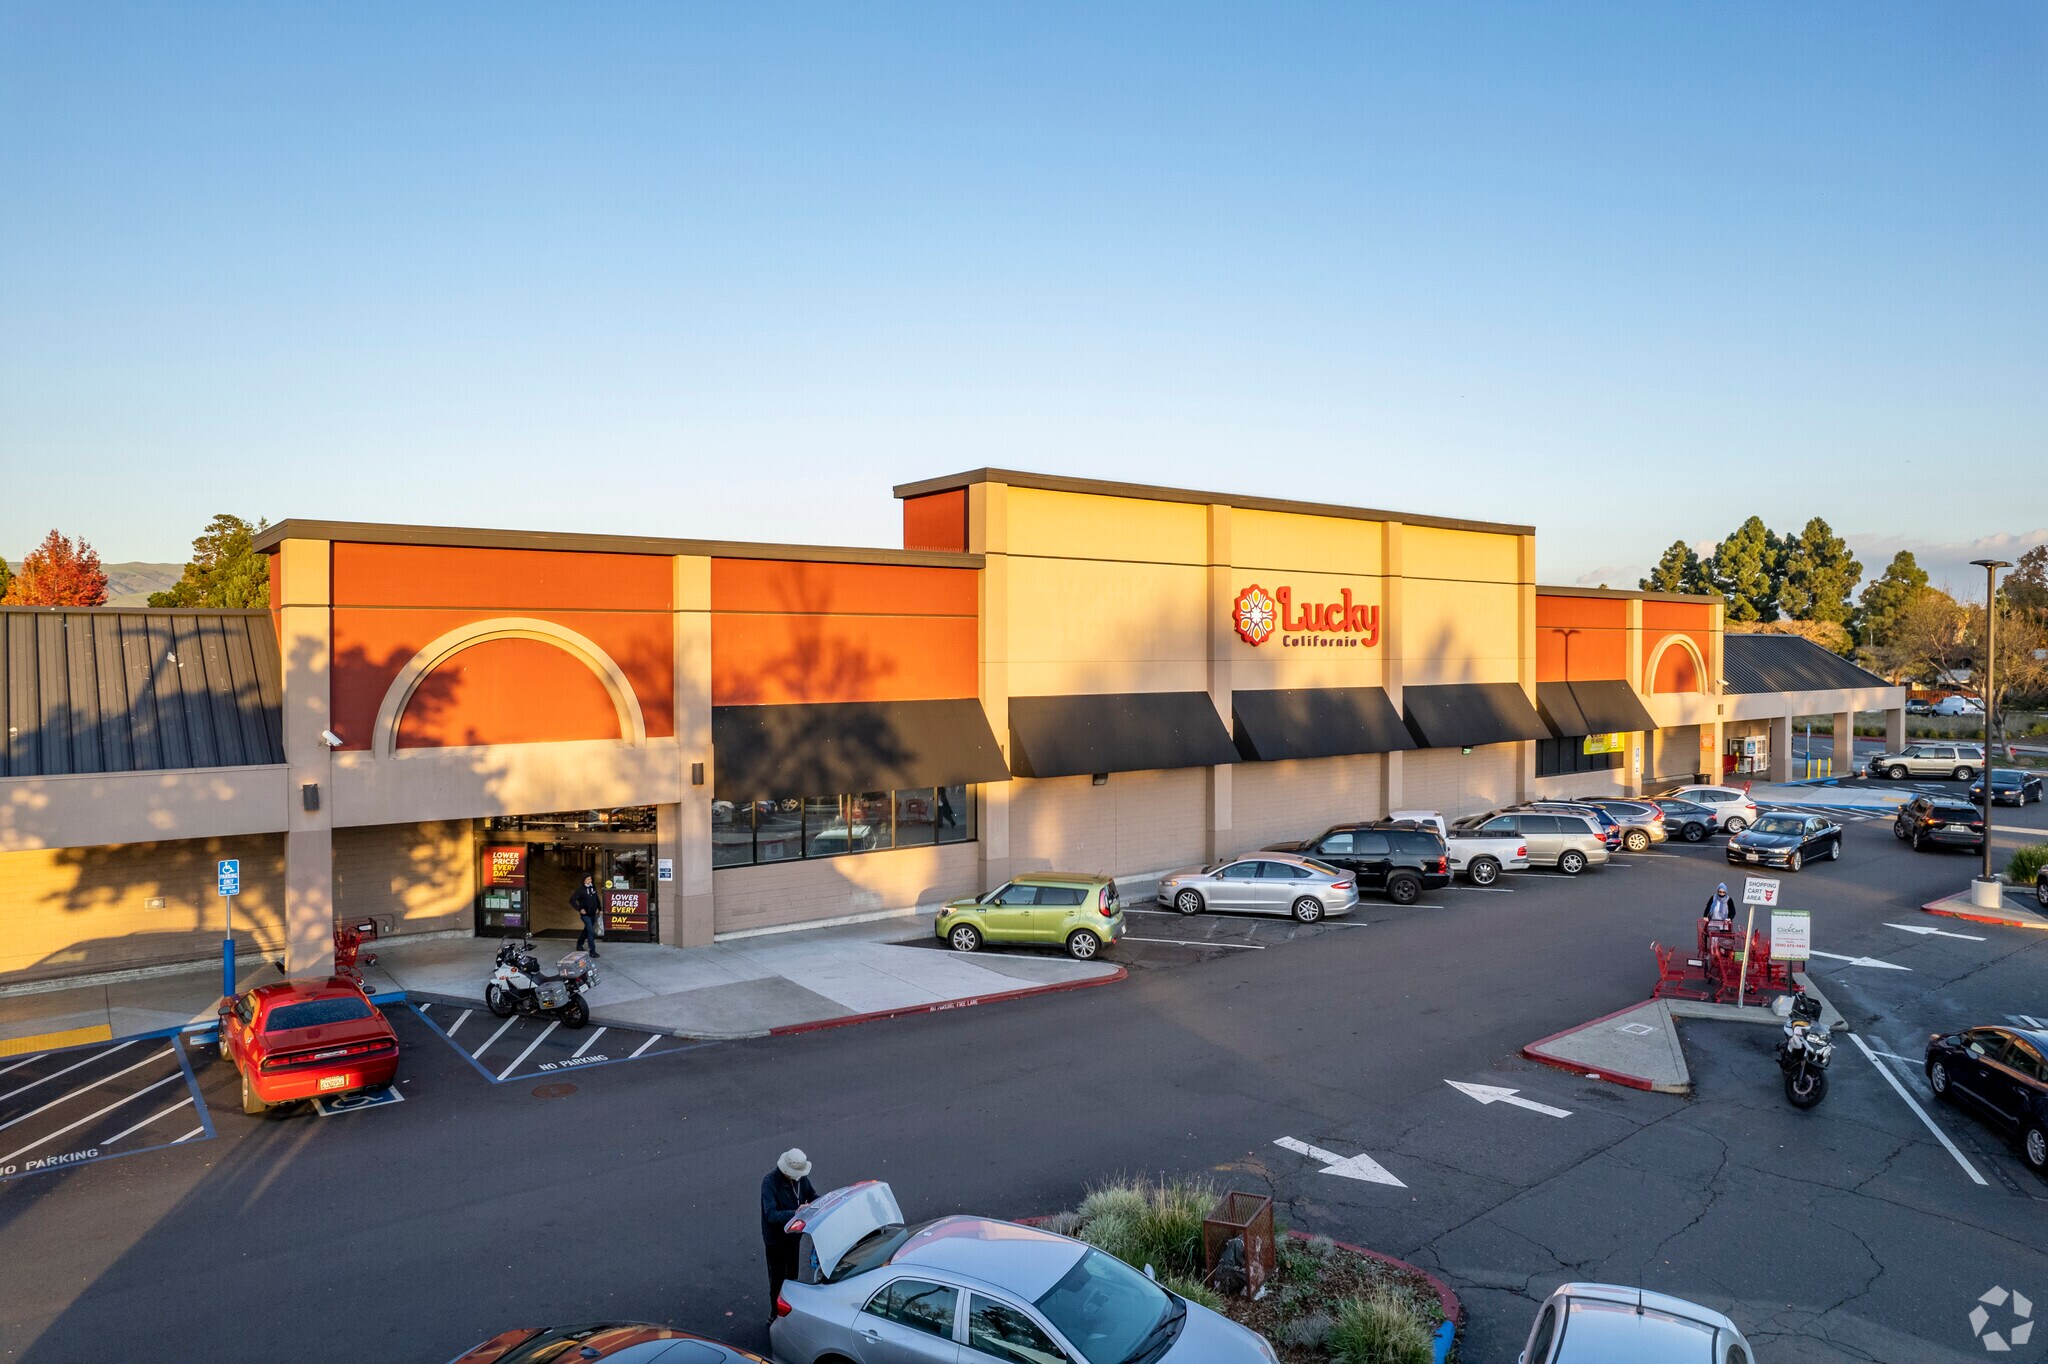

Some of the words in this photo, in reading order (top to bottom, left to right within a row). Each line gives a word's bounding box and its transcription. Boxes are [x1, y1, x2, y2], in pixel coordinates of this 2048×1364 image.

[1276, 586, 1380, 648] Lucky
[1282, 634, 1358, 648] California
[539, 1063, 558, 1071] NO
[559, 1054, 609, 1067] PARKING
[25, 1148, 98, 1171] PARKING
